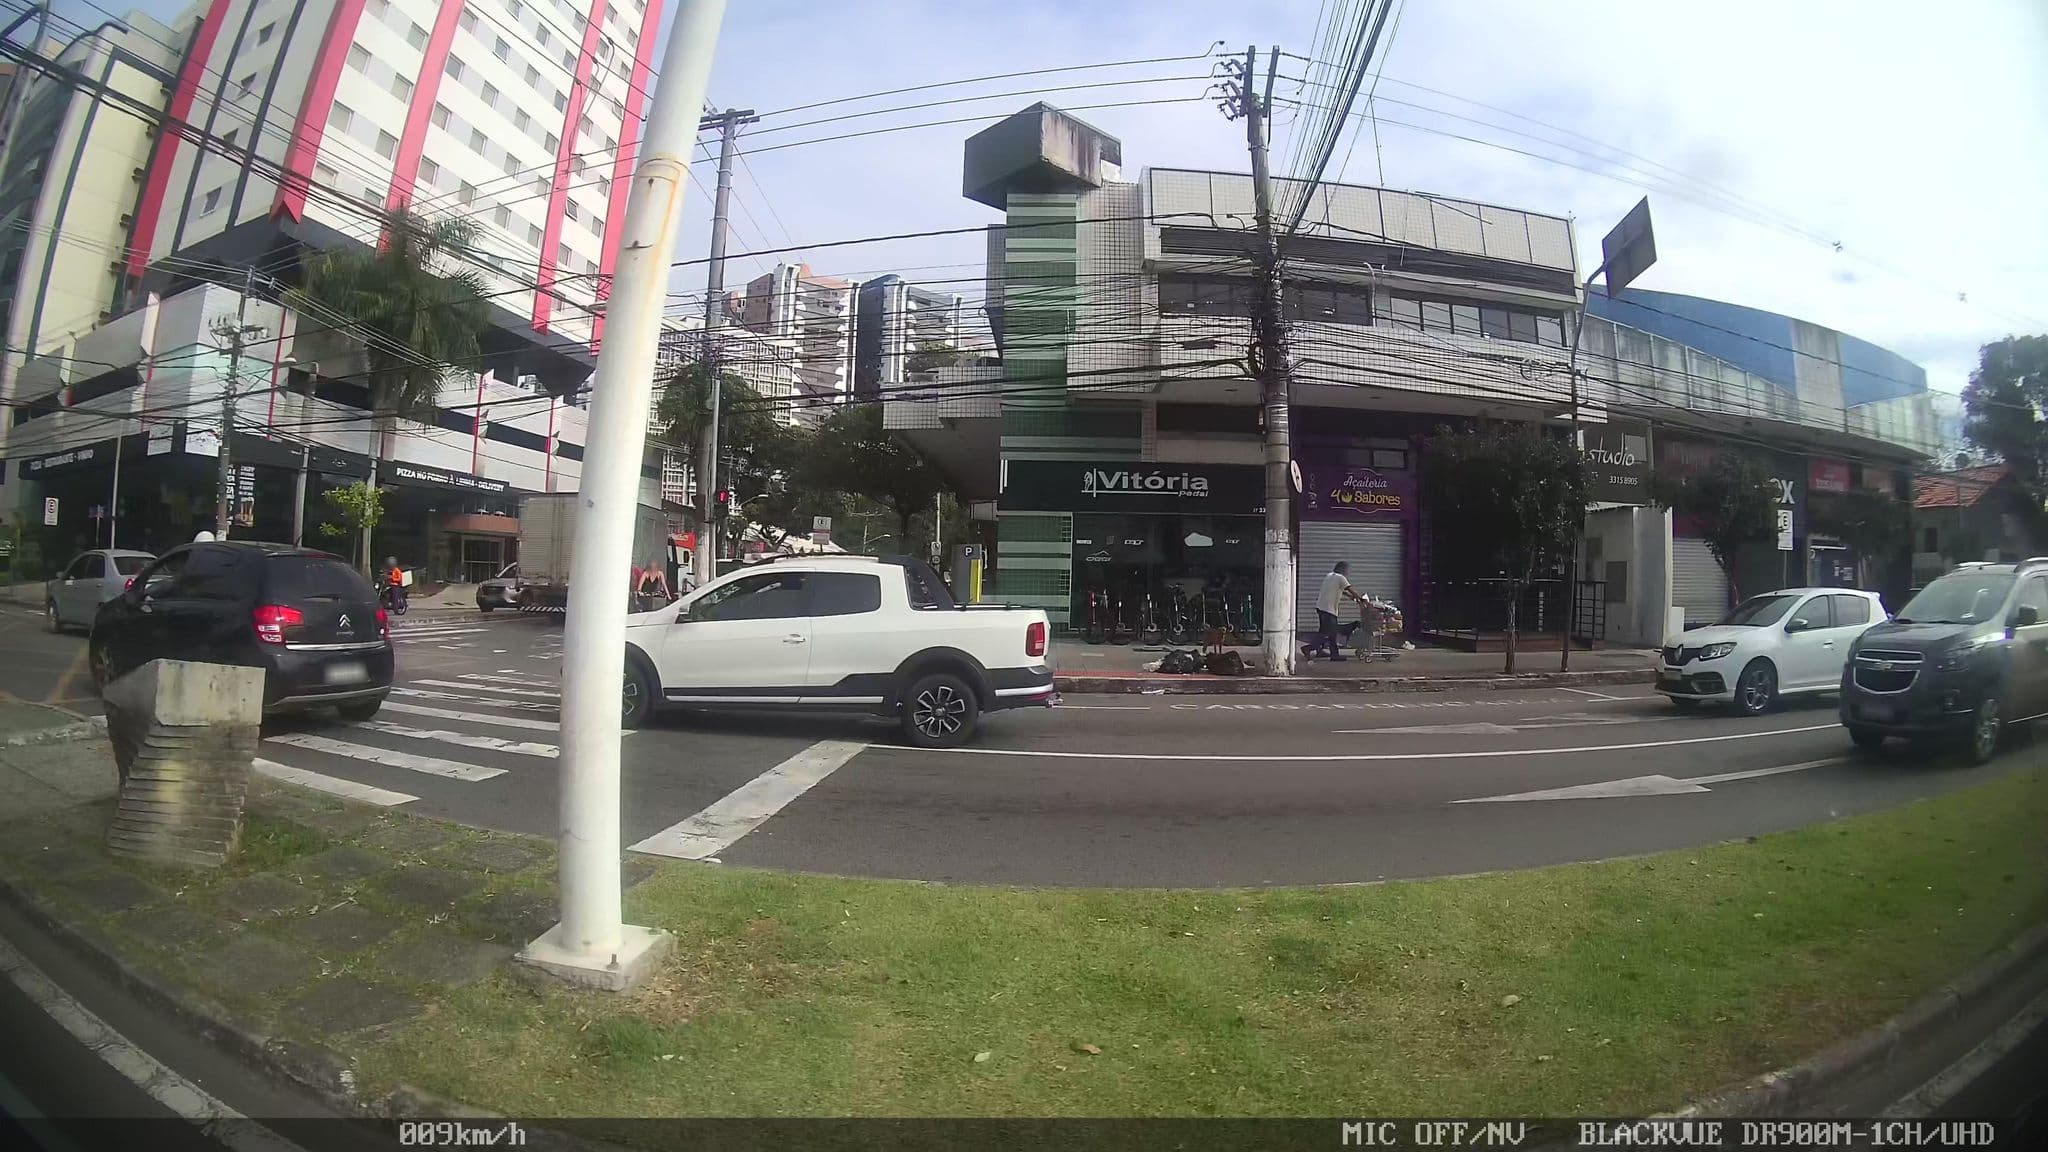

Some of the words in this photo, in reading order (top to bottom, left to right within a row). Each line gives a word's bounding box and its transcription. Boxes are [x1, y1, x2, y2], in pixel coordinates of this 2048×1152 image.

[1097, 471, 1209, 490] Vitória
[1354, 491, 1401, 506] Sabores
[965, 547, 973, 556] P
